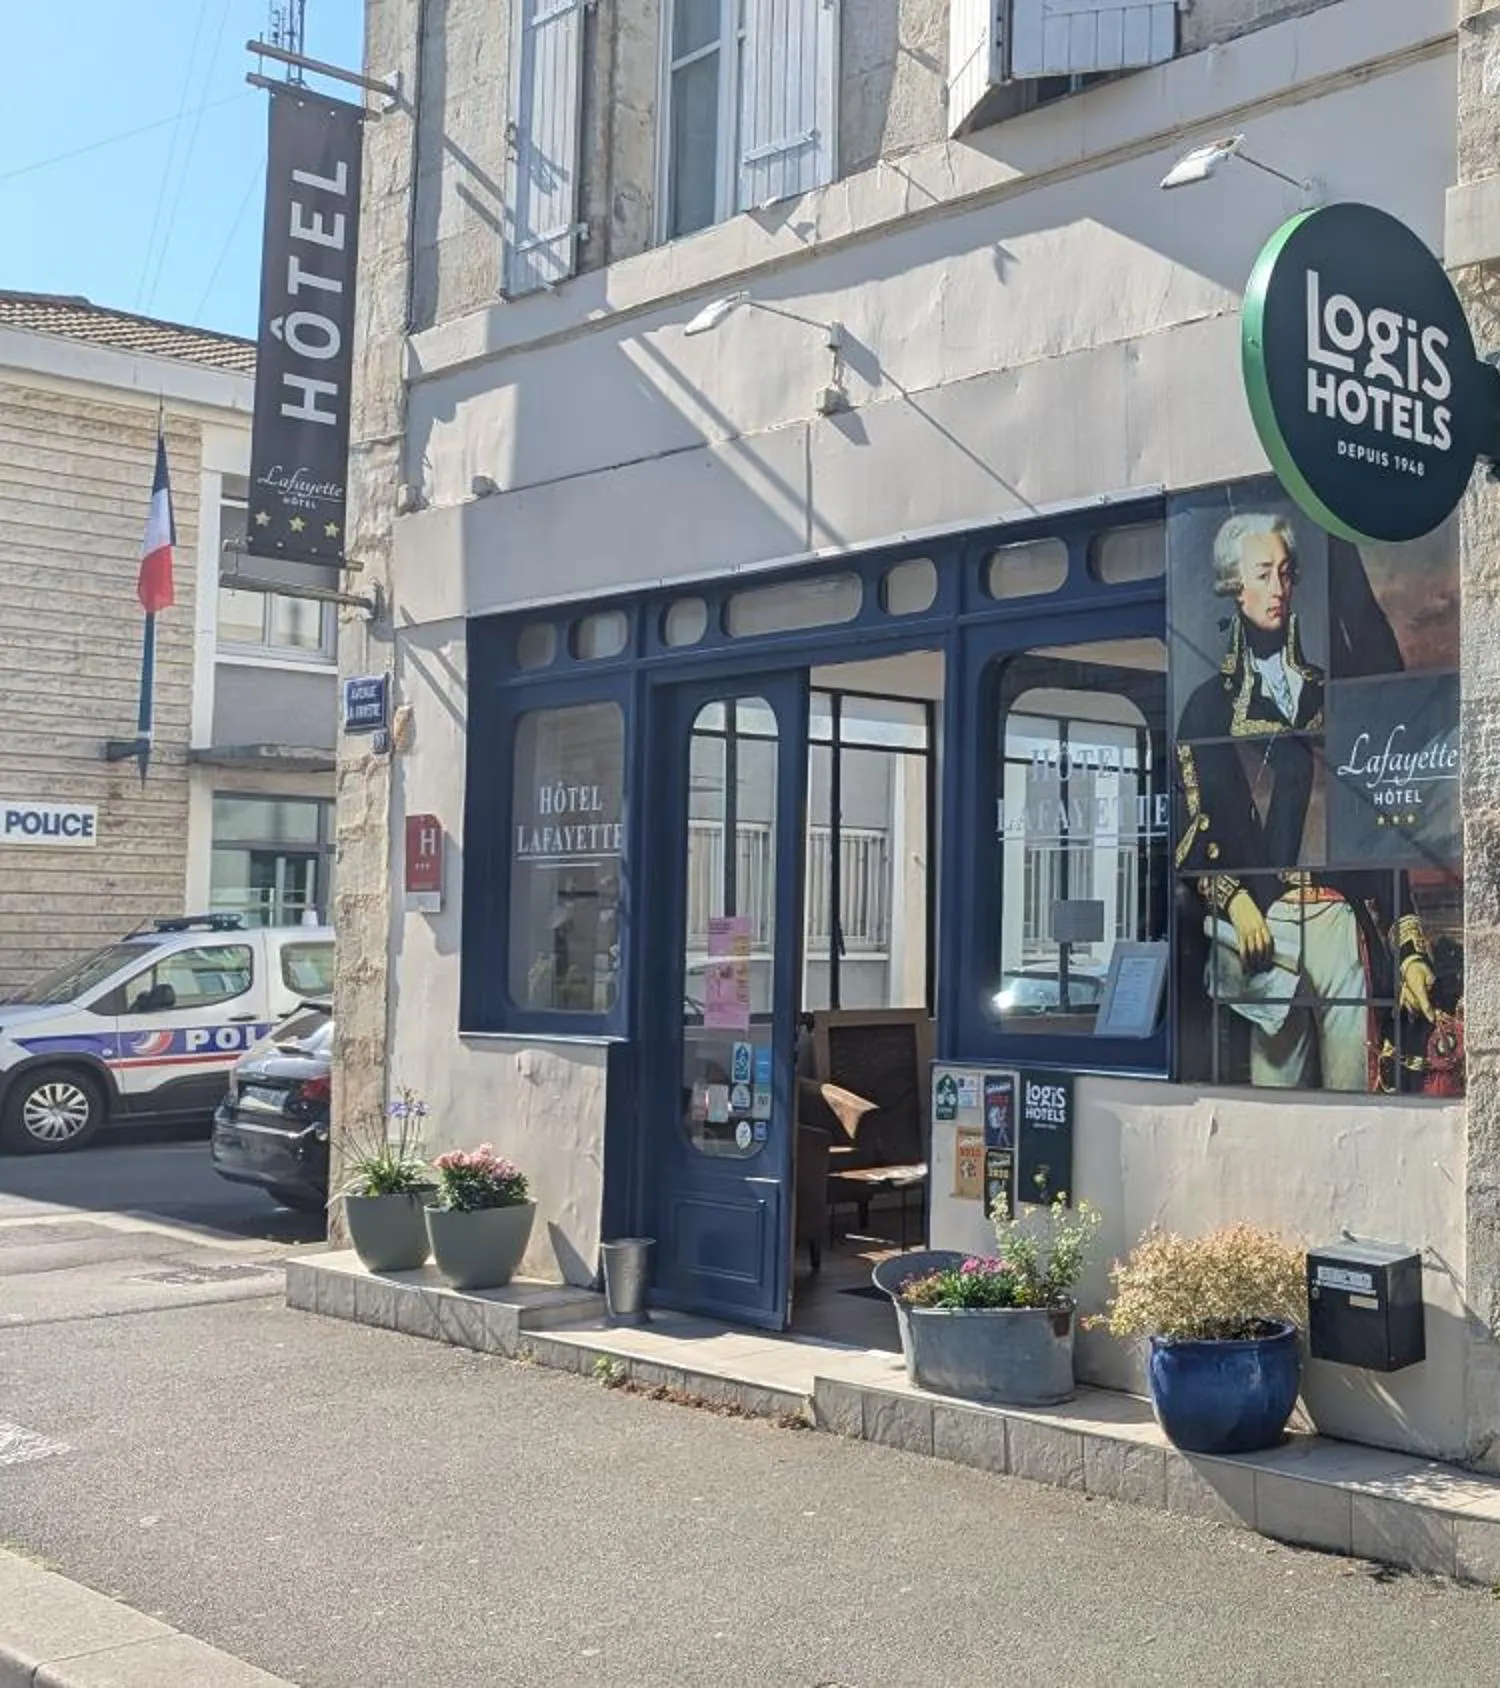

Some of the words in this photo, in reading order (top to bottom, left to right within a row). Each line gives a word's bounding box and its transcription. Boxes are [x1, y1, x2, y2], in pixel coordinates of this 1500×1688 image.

[269, 160, 349, 426] HÔTEL
[1307, 367, 1452, 451] HOTELS
[1337, 440, 1389, 467] DEPUIS
[1394, 455, 1425, 477] 1948
[256, 465, 343, 498] Lafayette
[1336, 725, 1459, 788] Lafayette
[539, 781, 603, 815] HÔTEL
[1373, 788, 1423, 805] HÔTEL
[5, 810, 94, 838] POLICE
[517, 823, 624, 853] LAFAYETTE
[421, 828, 435, 856] H
[1025, 1107, 1066, 1123] HOTELS
